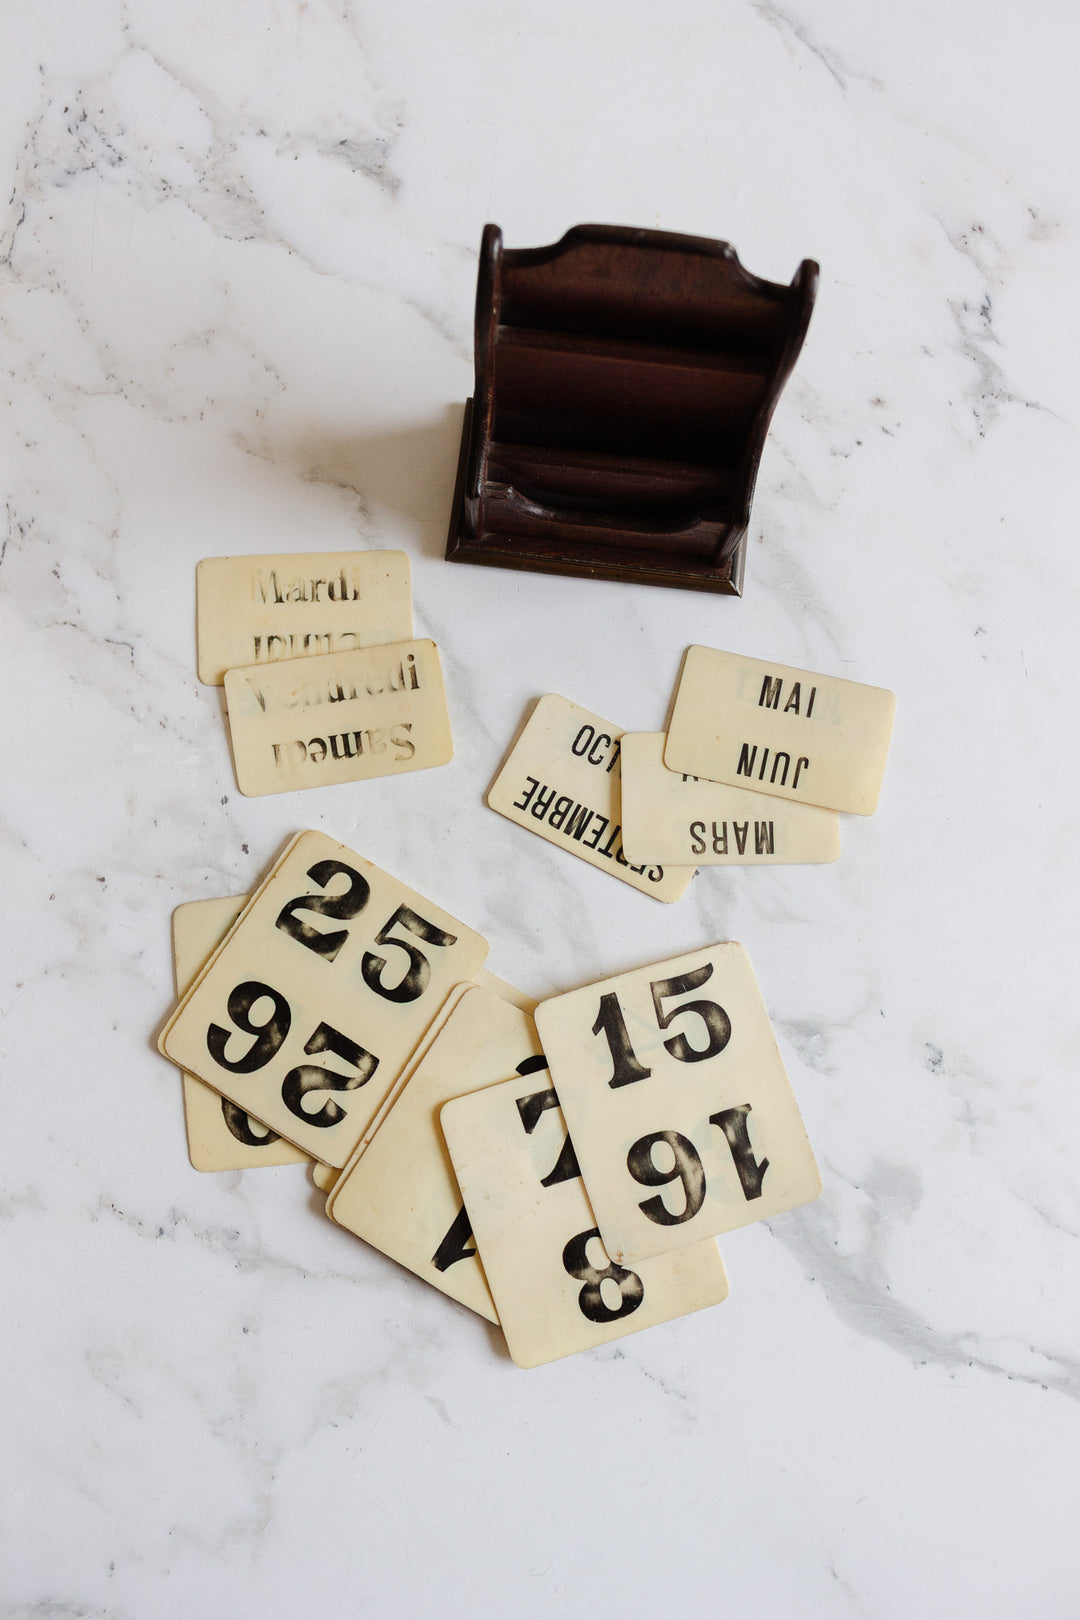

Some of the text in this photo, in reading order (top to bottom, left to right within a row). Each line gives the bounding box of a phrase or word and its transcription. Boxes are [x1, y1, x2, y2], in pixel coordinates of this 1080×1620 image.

[252, 566, 362, 604] Mardi
[758, 675, 817, 719] MAI
[571, 724, 622, 779] OCT
[736, 742, 810, 789] JUIN
[513, 775, 664, 883] STEMBRE
[689, 821, 775, 855] MARS
[275, 859, 458, 1004] 25
[207, 980, 380, 1128] 26
[591, 962, 732, 1090] 15
[627, 1103, 770, 1227] 16
[562, 1227, 645, 1324] 8
